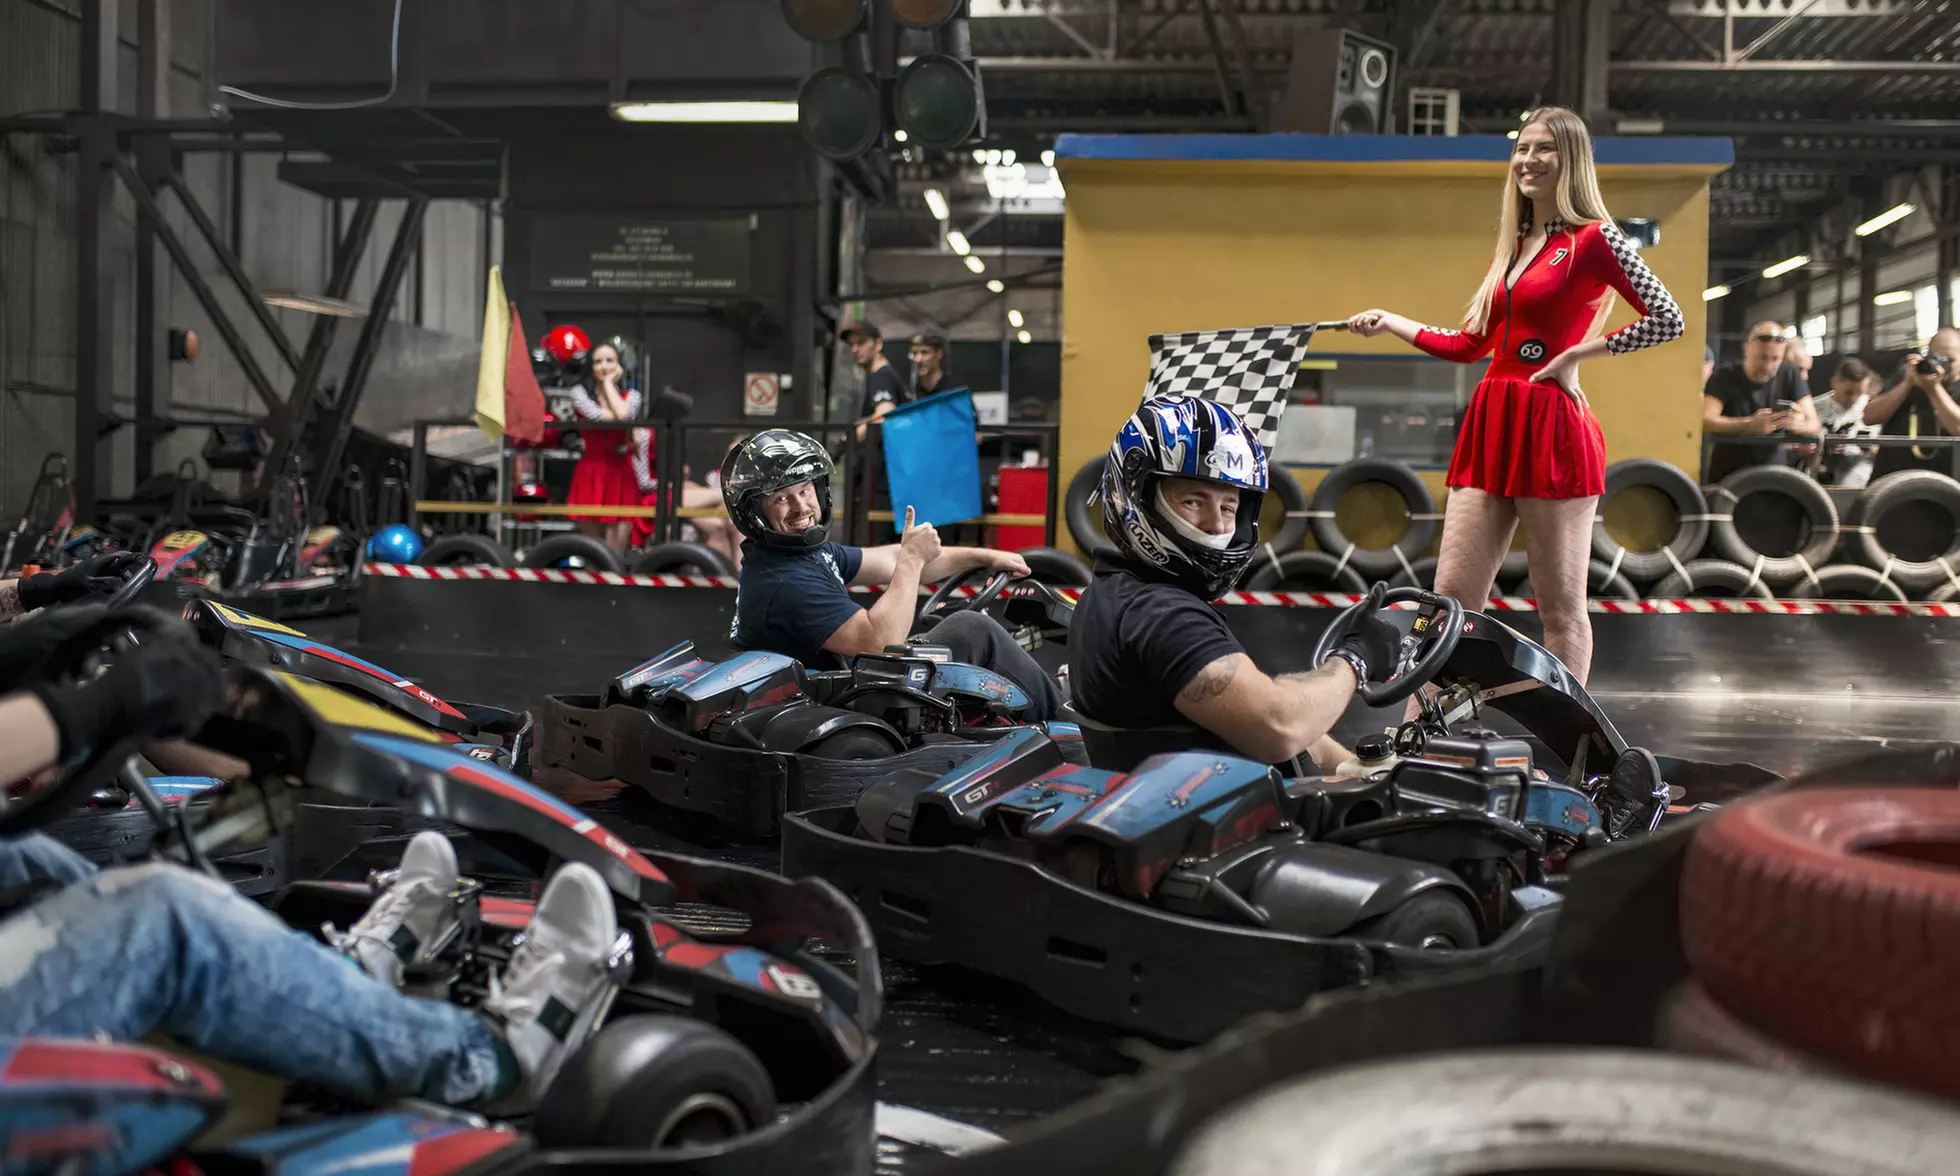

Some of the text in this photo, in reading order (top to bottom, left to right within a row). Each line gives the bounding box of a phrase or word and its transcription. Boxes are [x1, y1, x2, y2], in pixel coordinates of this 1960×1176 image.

[1549, 248, 1568, 266] 7
[1520, 343, 1543, 359] 69
[1226, 450, 1243, 471] M
[1130, 522, 1166, 563] LAZER
